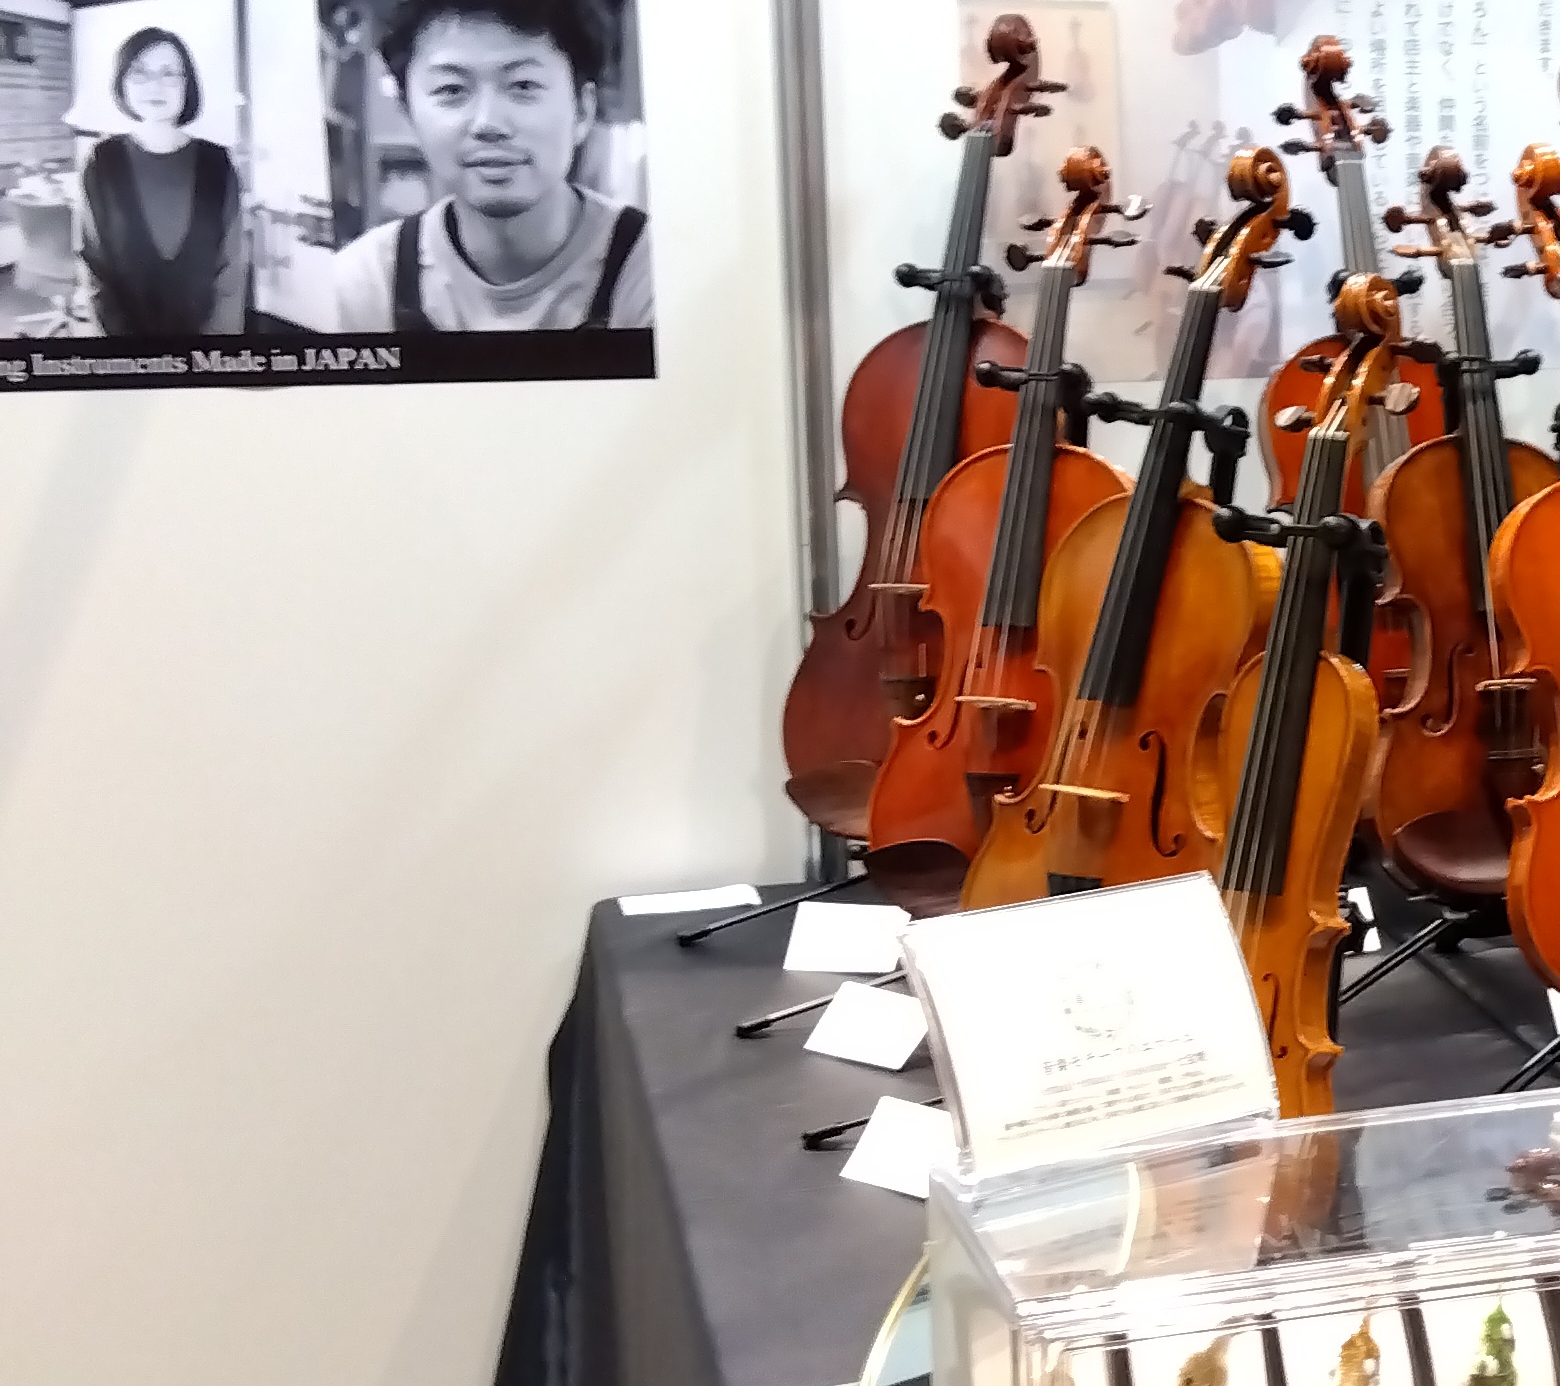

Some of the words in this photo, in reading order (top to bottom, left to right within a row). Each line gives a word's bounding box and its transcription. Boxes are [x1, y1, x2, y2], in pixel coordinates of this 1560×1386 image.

[31, 353, 188, 376] Instruments
[190, 350, 268, 373] Made
[270, 349, 298, 371] in
[301, 347, 402, 371] JAPAN
